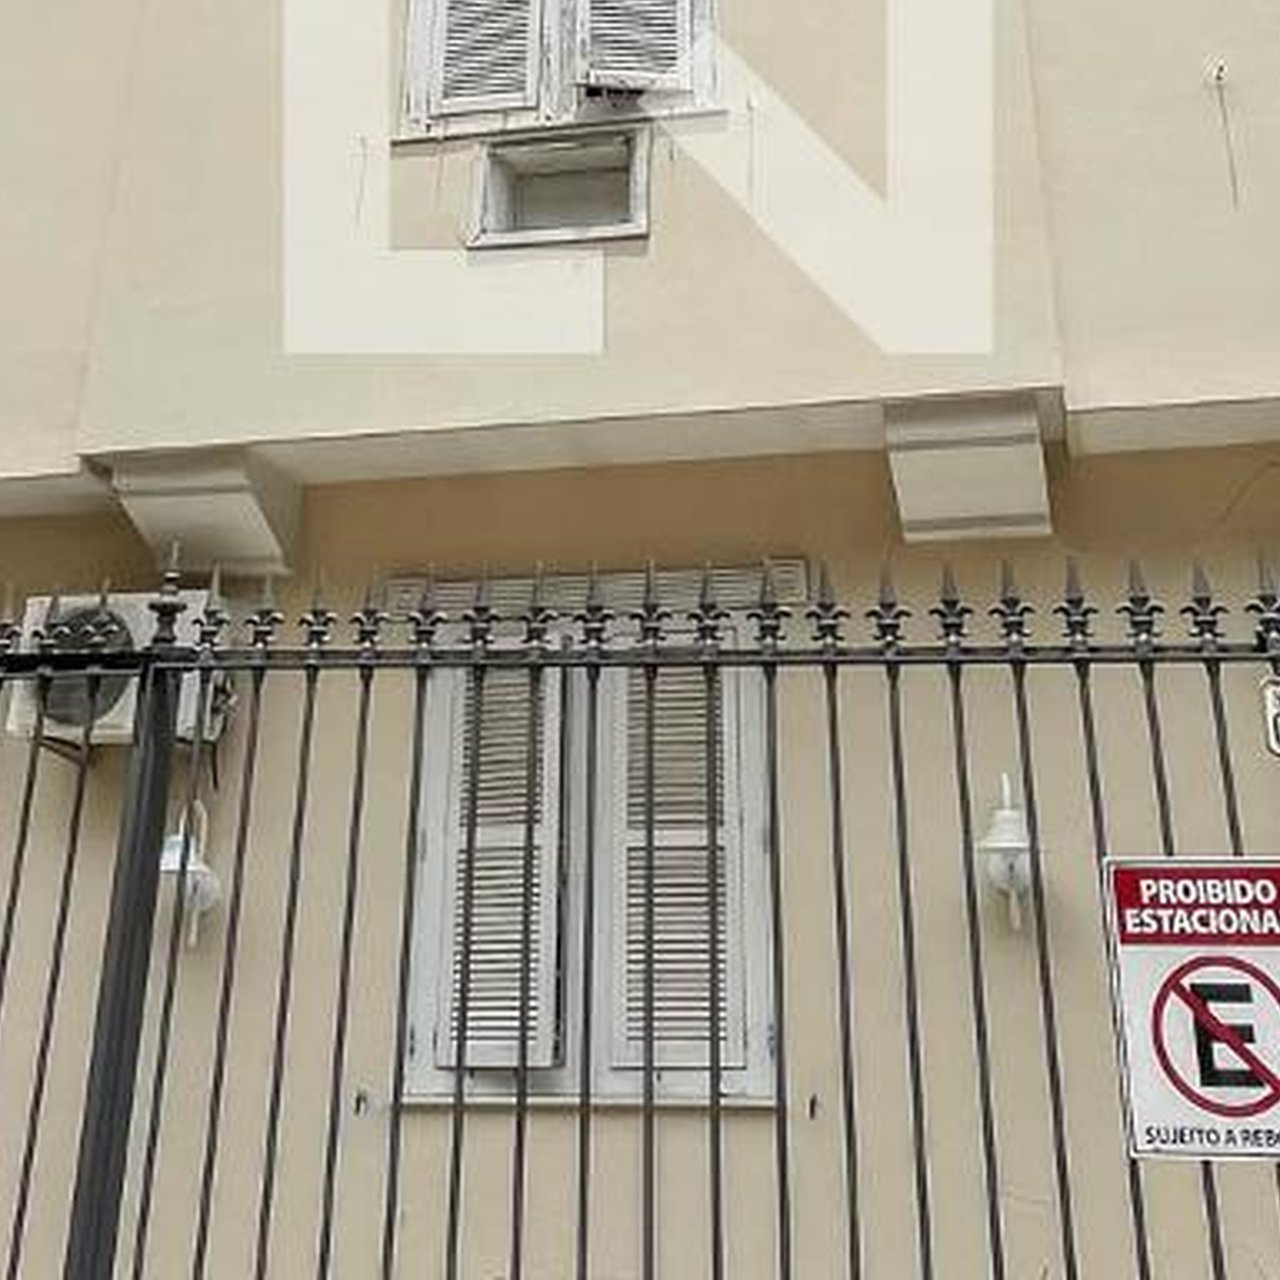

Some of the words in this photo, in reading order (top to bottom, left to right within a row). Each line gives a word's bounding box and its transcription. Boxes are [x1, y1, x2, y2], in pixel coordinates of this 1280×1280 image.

[1139, 878, 1277, 904] PROIBIDO
[1145, 1126, 1221, 1146] SUJEITO
[1224, 1129, 1238, 1147] A
